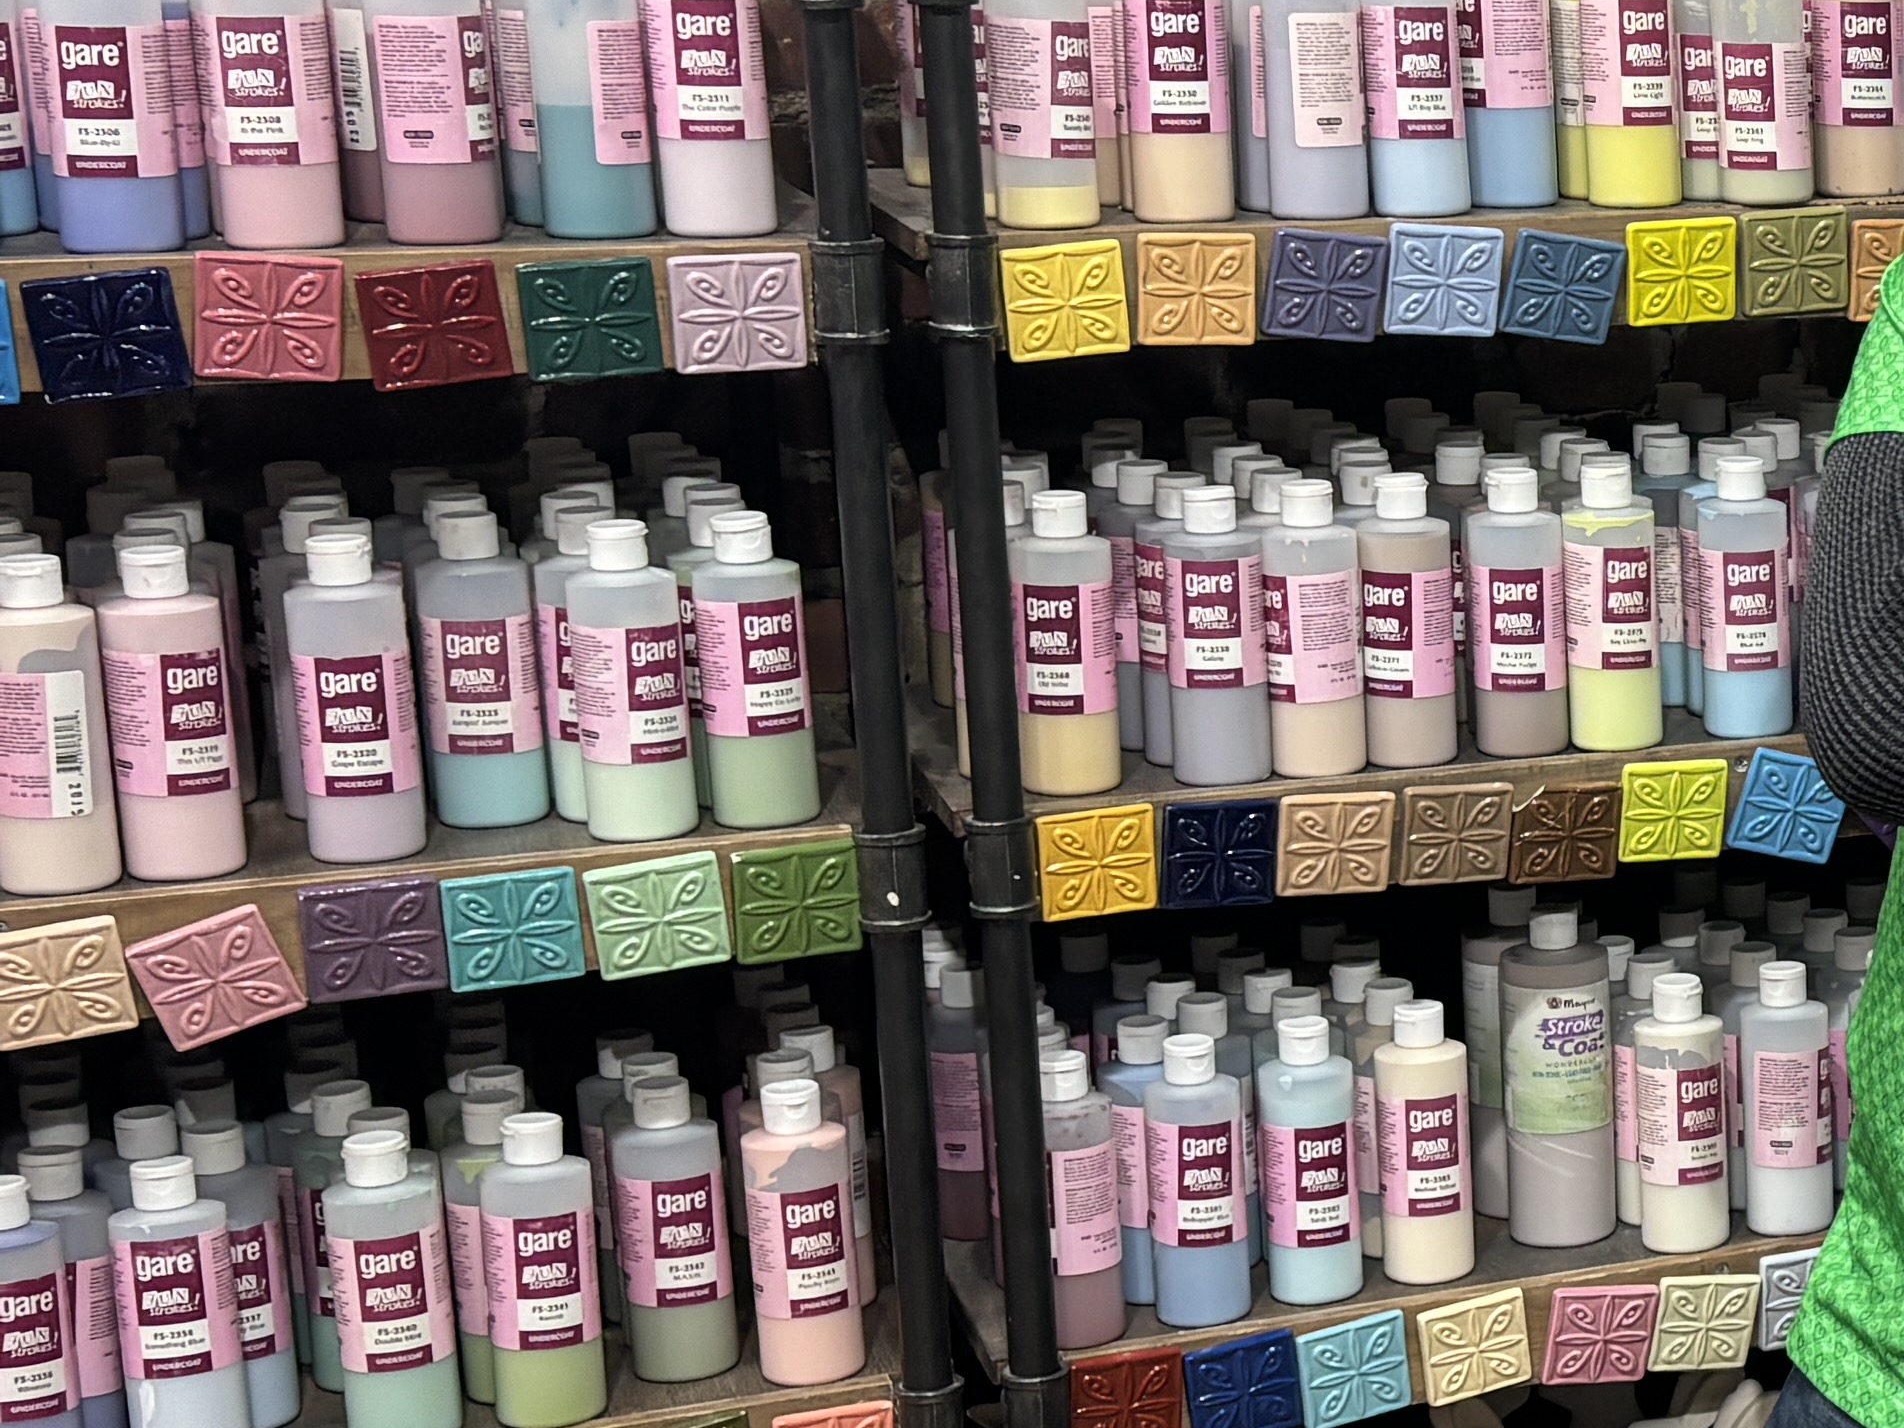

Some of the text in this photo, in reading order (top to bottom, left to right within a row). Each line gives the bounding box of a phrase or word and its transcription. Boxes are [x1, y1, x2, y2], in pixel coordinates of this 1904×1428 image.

[676, 12, 731, 40] gare
[1623, 10, 1665, 35] gare
[1844, 13, 1887, 38] gare
[61, 40, 120, 70] gare
[1492, 580, 1538, 605] gare
[1025, 596, 1074, 622] gare
[445, 633, 500, 659] gare
[166, 664, 218, 694] gare
[1409, 1105, 1454, 1133] gare
[785, 1199, 835, 1230] gare
[517, 1227, 573, 1257] gare
[135, 1251, 195, 1283] gare
